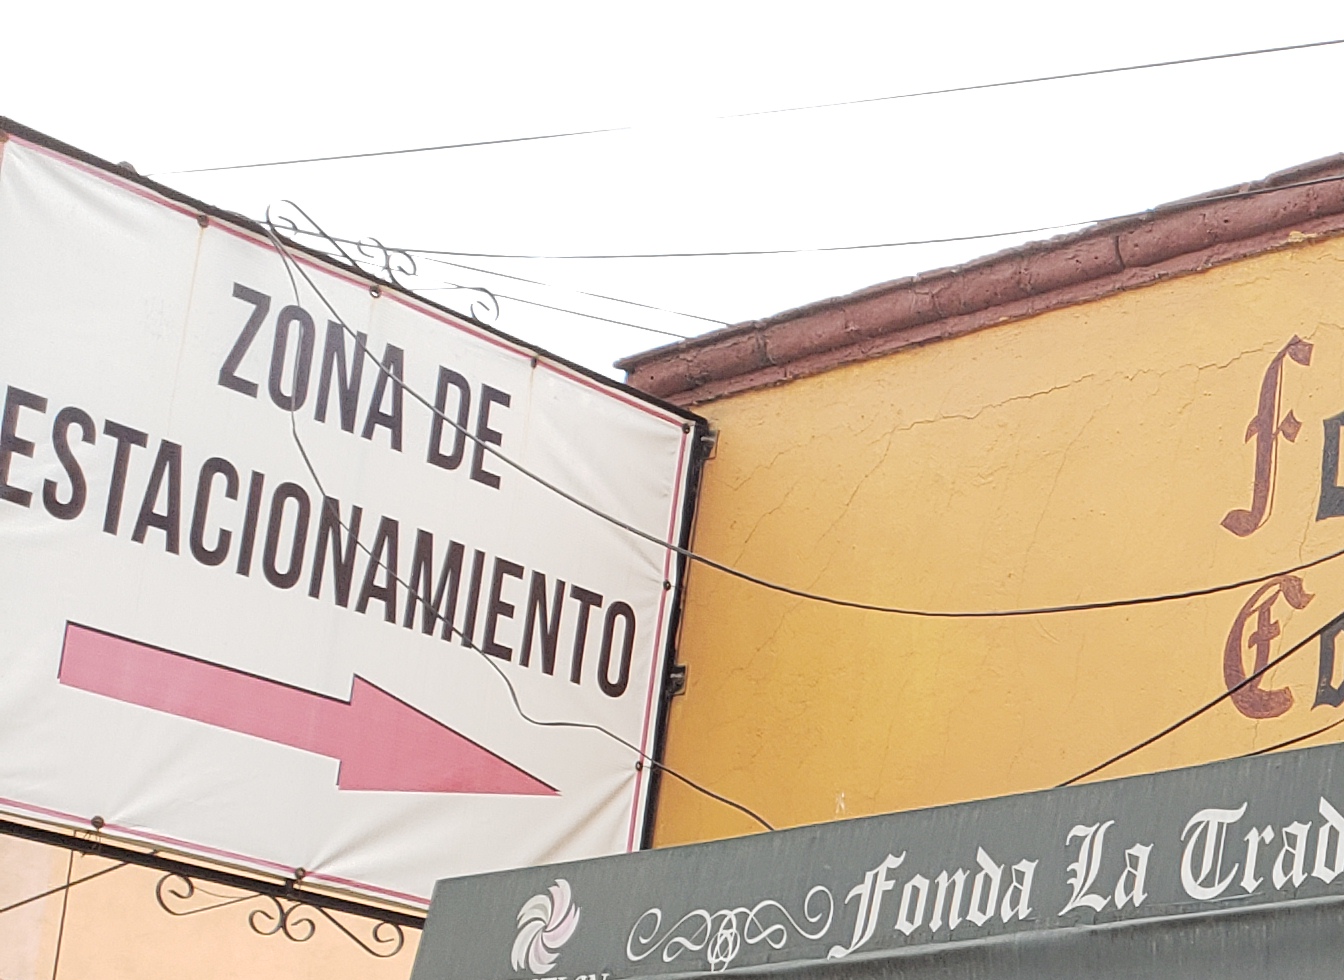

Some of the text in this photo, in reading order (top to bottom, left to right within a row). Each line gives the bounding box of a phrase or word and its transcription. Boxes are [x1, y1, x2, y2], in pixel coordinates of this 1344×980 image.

[218, 283, 512, 490] ZONA DE
[0, 385, 637, 698] ESTACIONAMIENTO
[829, 848, 1040, 959] Fonda
[1058, 819, 1155, 917] La
